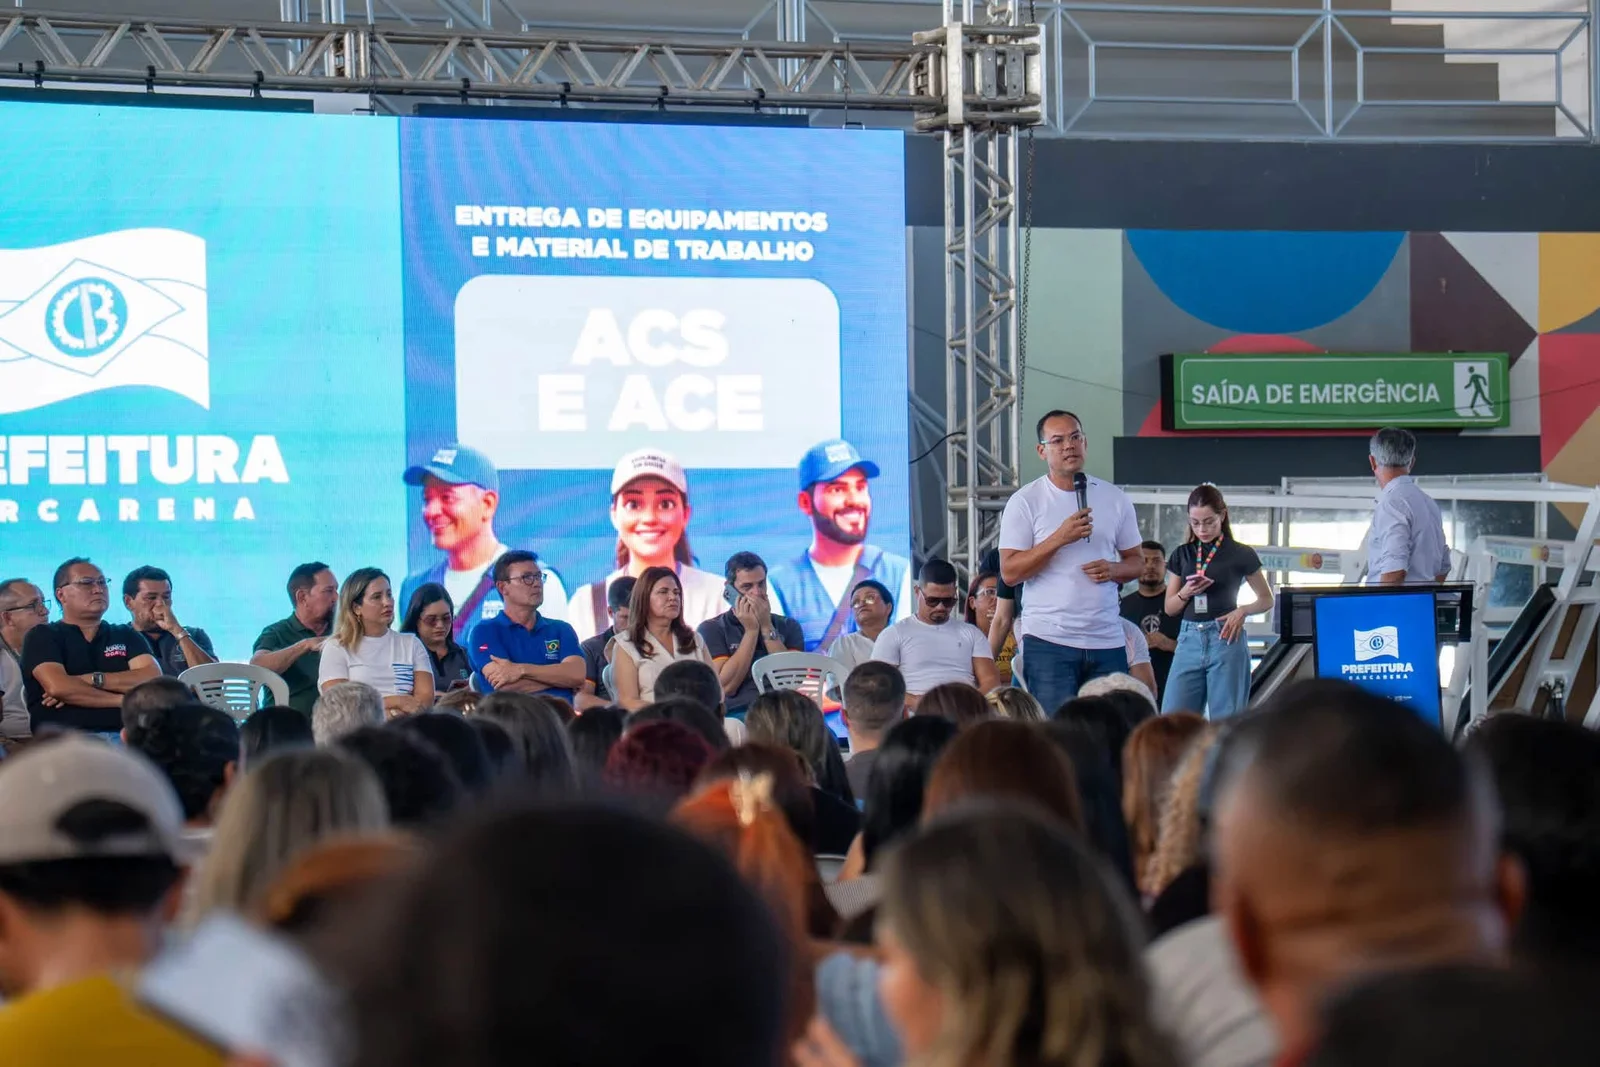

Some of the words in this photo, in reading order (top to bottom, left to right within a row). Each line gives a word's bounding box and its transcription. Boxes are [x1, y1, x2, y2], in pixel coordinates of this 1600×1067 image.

[455, 205, 581, 228] ENTREGA
[587, 208, 622, 229] DE
[628, 209, 828, 232] EQUIPAMENTOS
[471, 236, 489, 256] E
[496, 237, 628, 258] MATERIAL
[634, 240, 669, 260] DE
[675, 240, 814, 262] TRABALHO
[569, 307, 730, 368] ACS
[537, 374, 587, 431] E
[607, 373, 764, 432] ACE
[1191, 379, 1261, 405] SAÍDA
[1265, 384, 1294, 404] DE
[1299, 379, 1441, 404] EMERGÊNCIA
[0, 435, 290, 485] FEITURA
[1341, 662, 1414, 674] PREFEITURA
